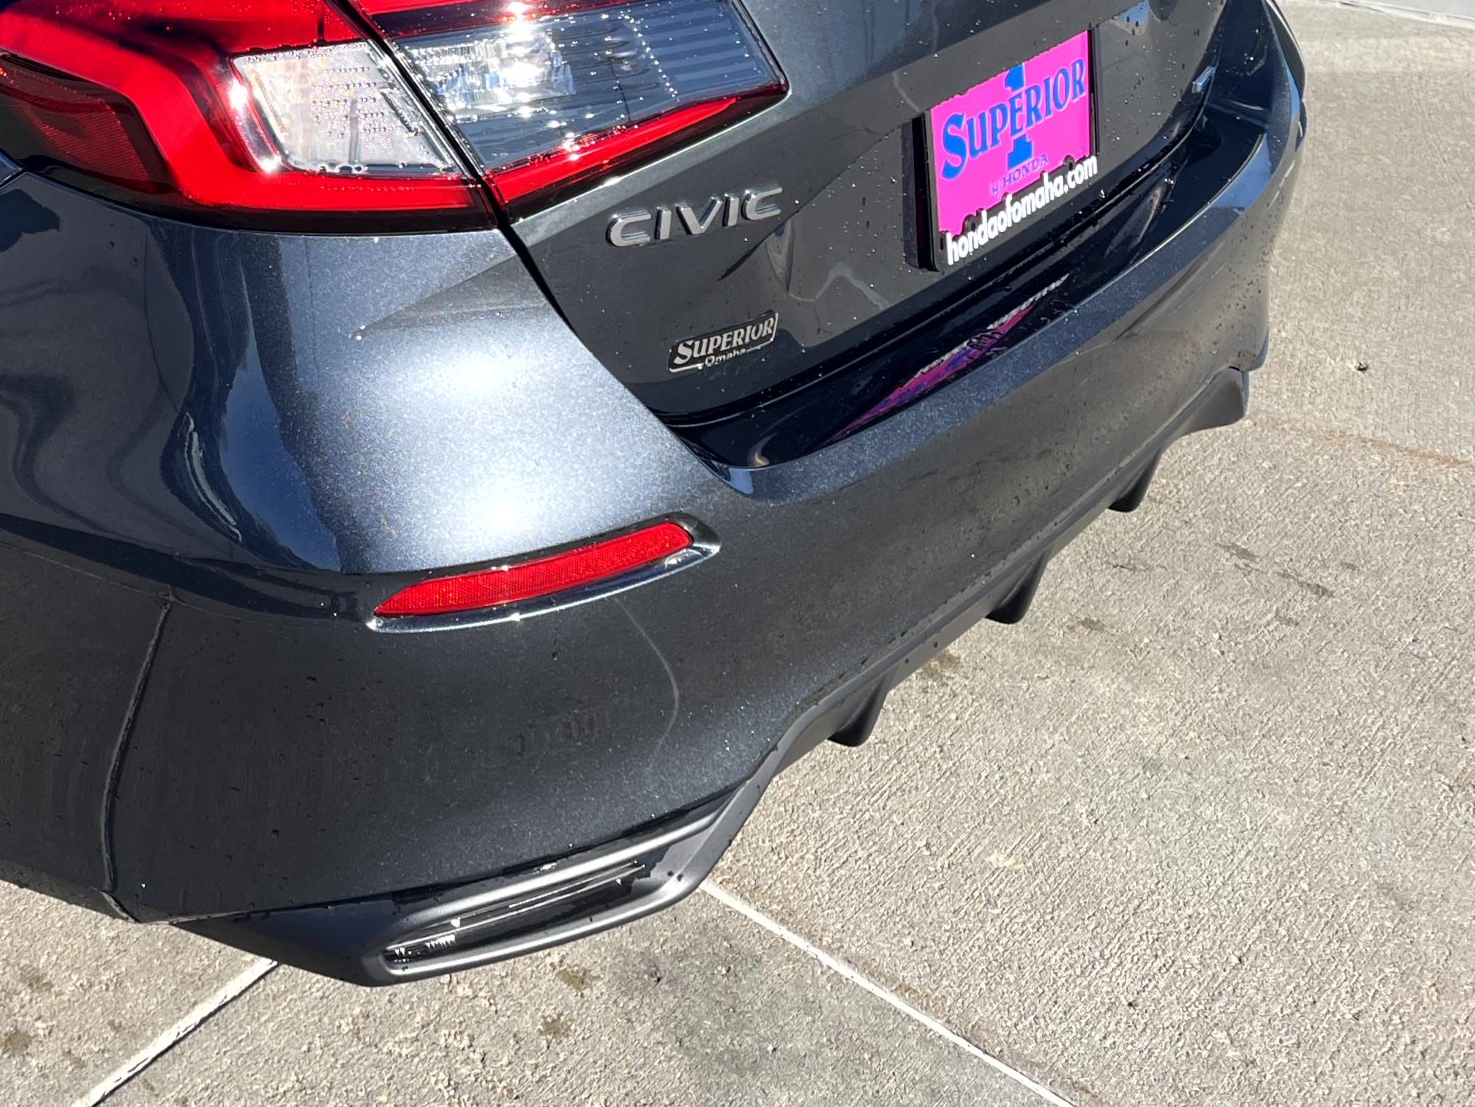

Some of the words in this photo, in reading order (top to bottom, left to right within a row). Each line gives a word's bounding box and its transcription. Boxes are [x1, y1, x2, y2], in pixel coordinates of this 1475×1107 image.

[941, 59, 1086, 180] SUPERIOR
[1003, 153, 1050, 186] HONDA
[605, 182, 783, 247] CIVIC
[945, 155, 1098, 266] hondaofomaha.com
[673, 316, 775, 365] SUPERIOR
[704, 347, 747, 367] Omaha
